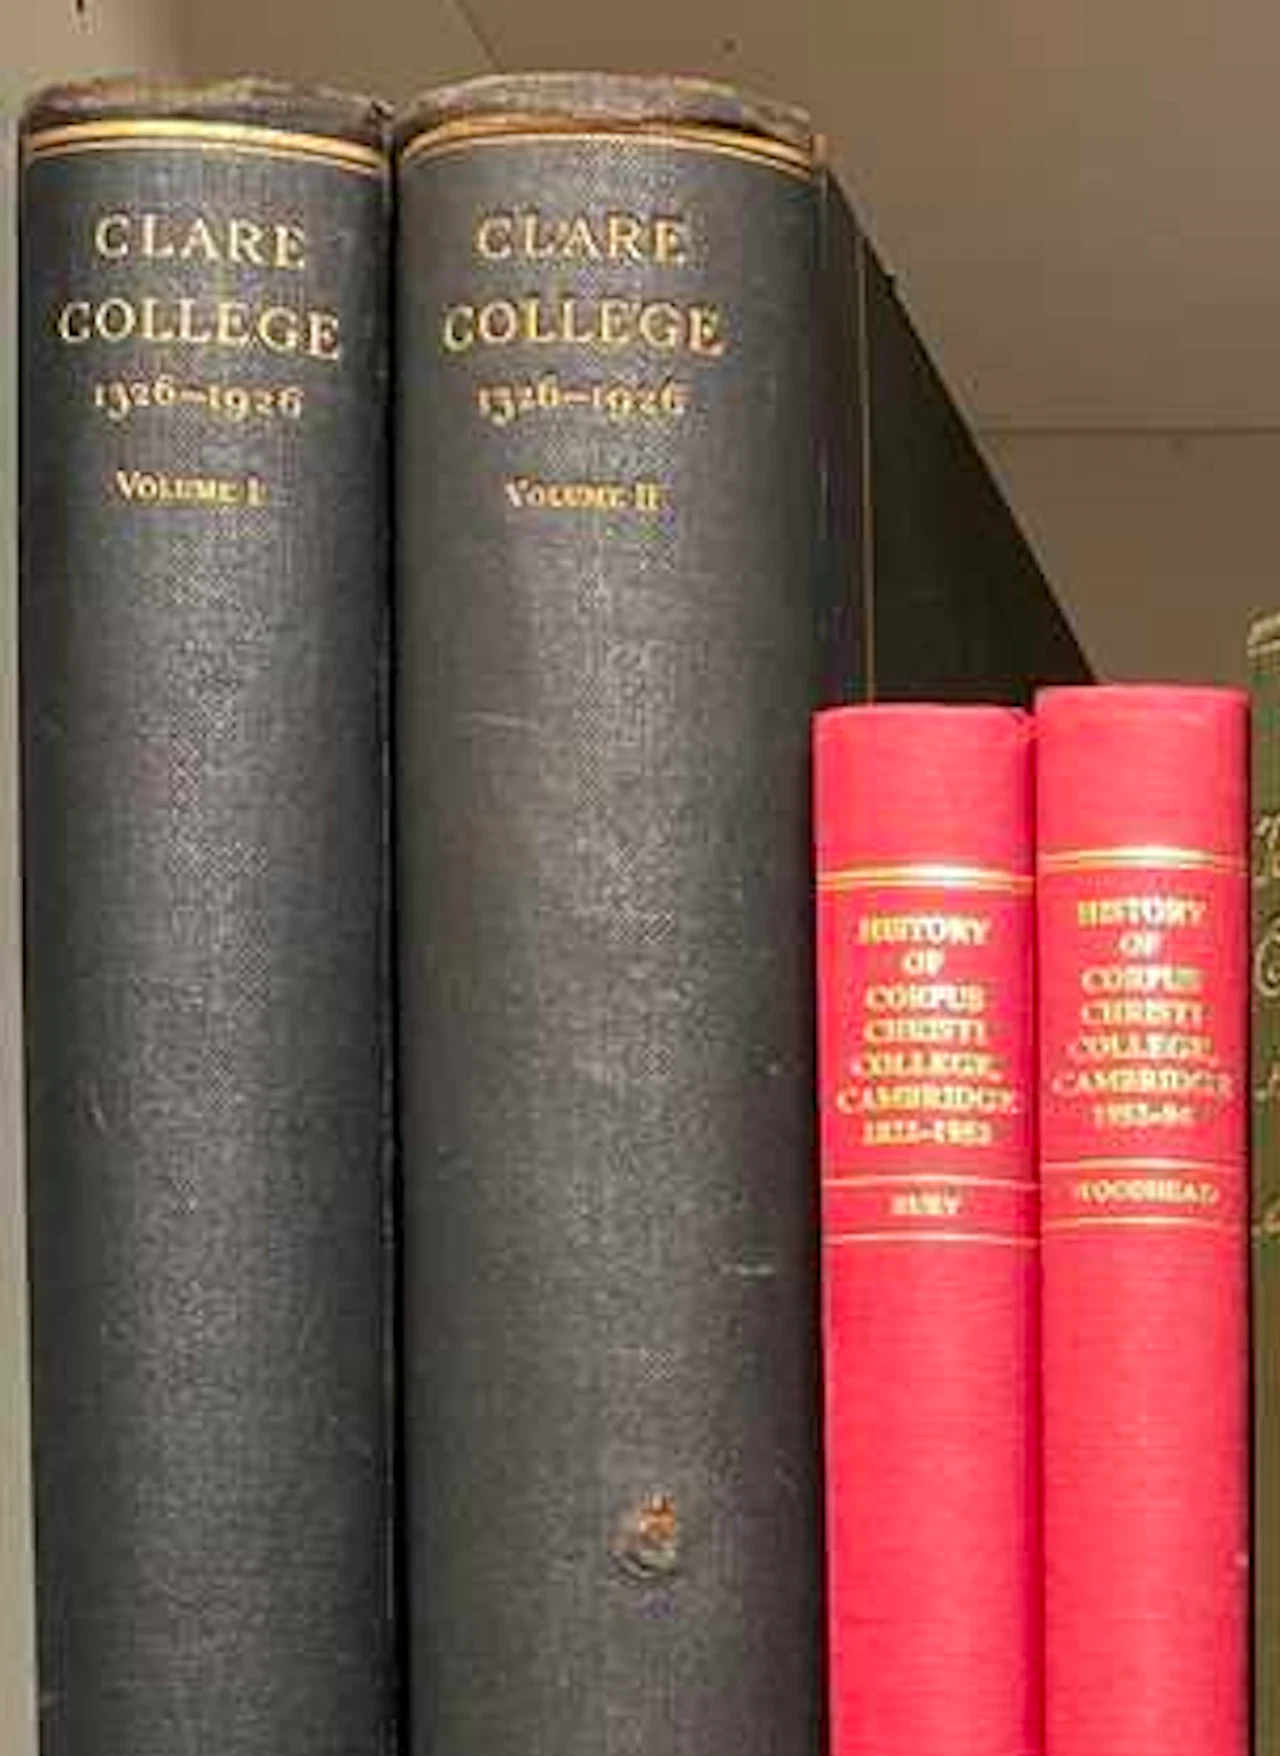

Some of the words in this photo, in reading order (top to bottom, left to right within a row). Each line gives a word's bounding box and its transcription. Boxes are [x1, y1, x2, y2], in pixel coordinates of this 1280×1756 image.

[95, 213, 308, 270] CLARE
[477, 213, 689, 266] CLARE
[58, 297, 341, 362] COLLEGE
[442, 297, 726, 359] COLLEGE
[1076, 895, 1207, 927] HISTORY
[858, 913, 990, 945] HISTORY
[1118, 931, 1163, 959] OF
[903, 949, 946, 975] OF
[1081, 965, 1202, 994] CORPUS
[866, 984, 987, 1013] CORPUS
